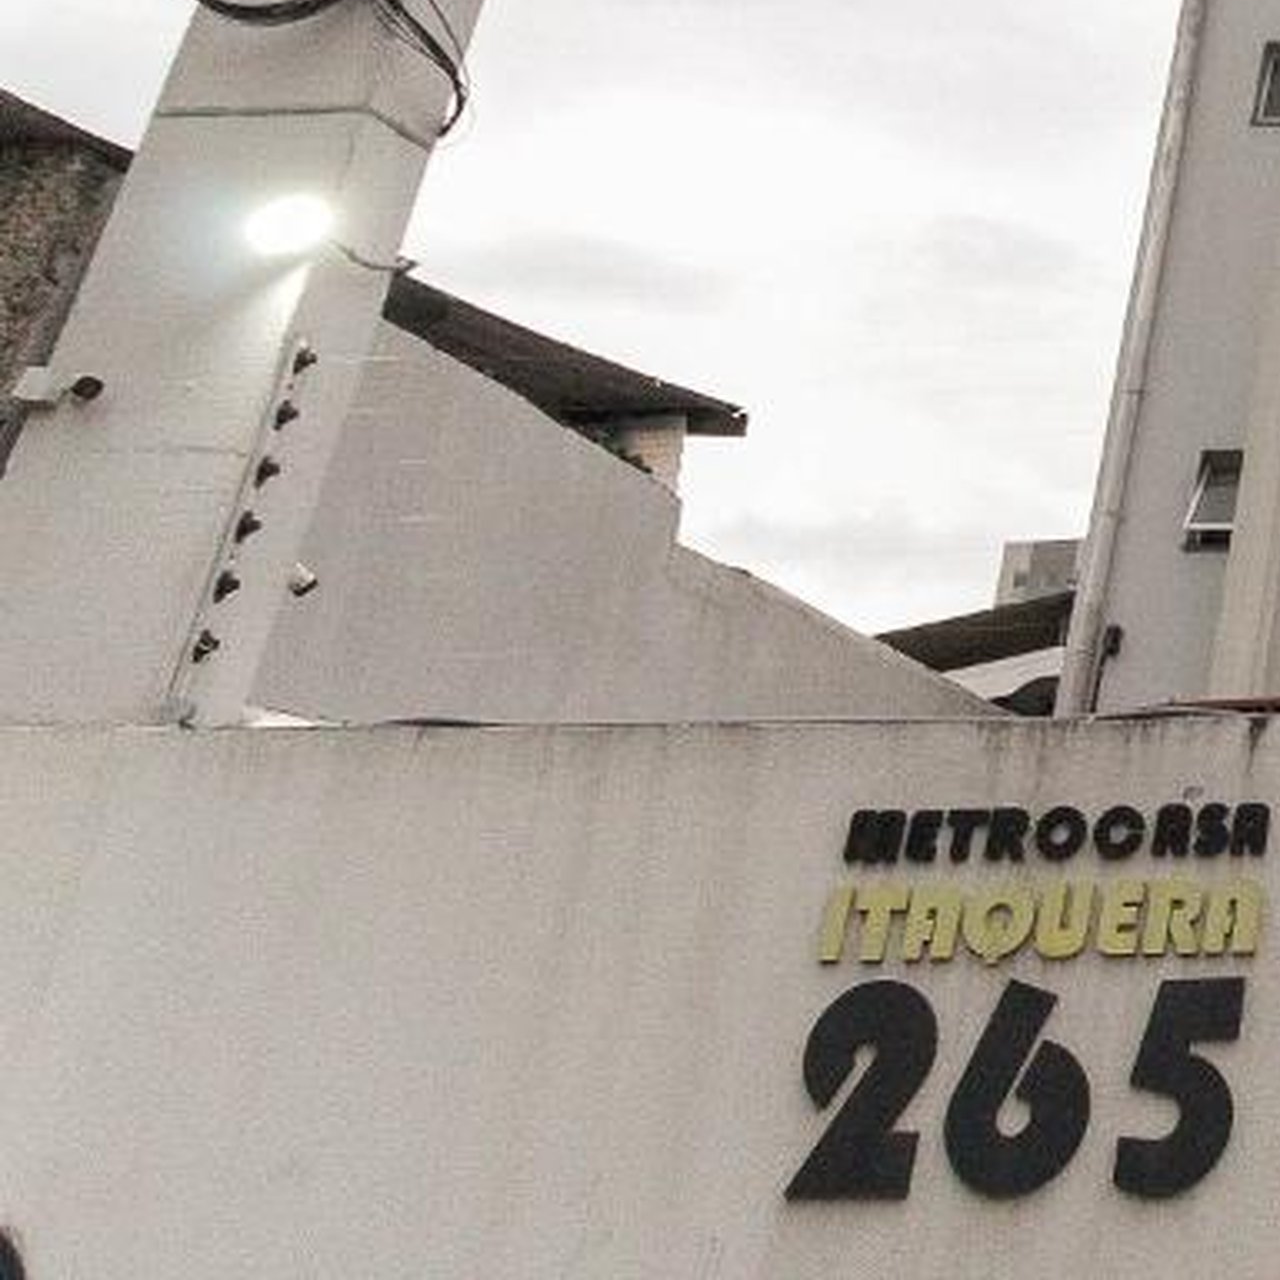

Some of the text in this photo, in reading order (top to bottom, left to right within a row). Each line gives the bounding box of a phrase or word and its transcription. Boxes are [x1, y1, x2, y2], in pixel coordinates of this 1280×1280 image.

[843, 802, 1271, 864] METROCASA
[817, 878, 1264, 967] ITAQUERA
[783, 976, 1247, 1202] 265
